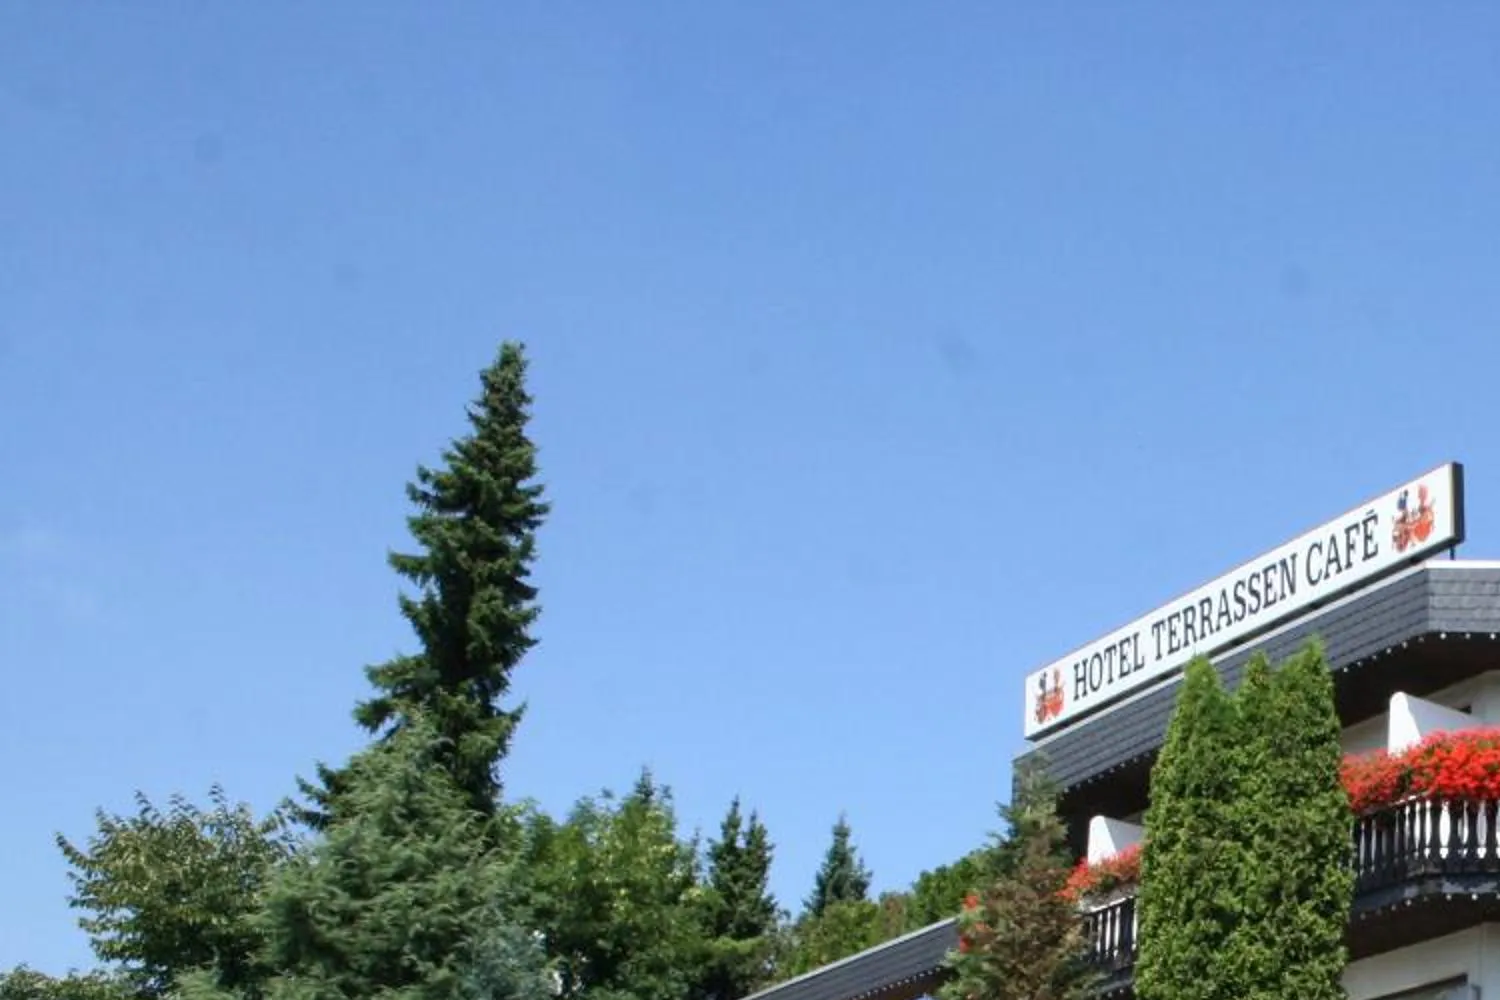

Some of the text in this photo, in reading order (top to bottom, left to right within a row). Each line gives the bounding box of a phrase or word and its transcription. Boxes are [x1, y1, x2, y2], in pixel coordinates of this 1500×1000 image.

[1073, 508, 1379, 702] HOTEL TERRASSEN CAFÉ
